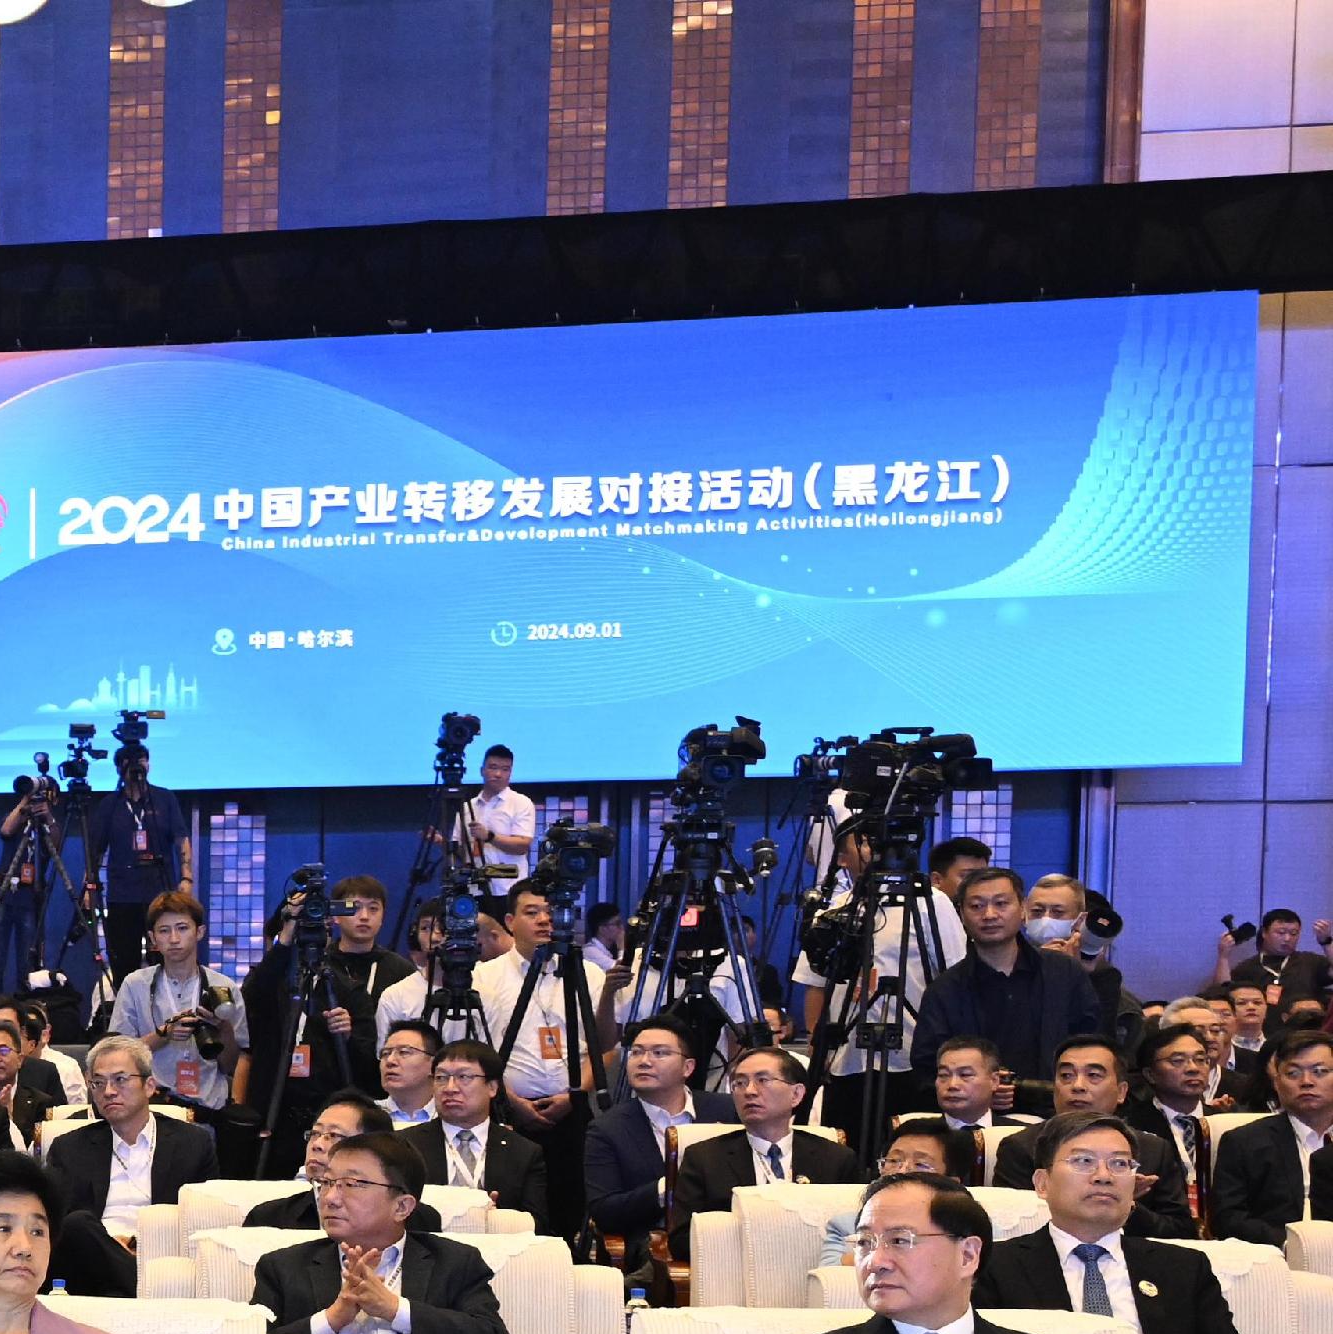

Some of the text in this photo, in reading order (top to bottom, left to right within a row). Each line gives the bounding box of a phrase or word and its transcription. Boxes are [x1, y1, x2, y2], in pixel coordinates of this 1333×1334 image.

[221, 536, 275, 551] China
[282, 532, 376, 549] Industrial
[382, 524, 608, 546] Transfer&Development
[615, 519, 748, 537] Matchmaking
[527, 622, 622, 641] 2024.09.01
